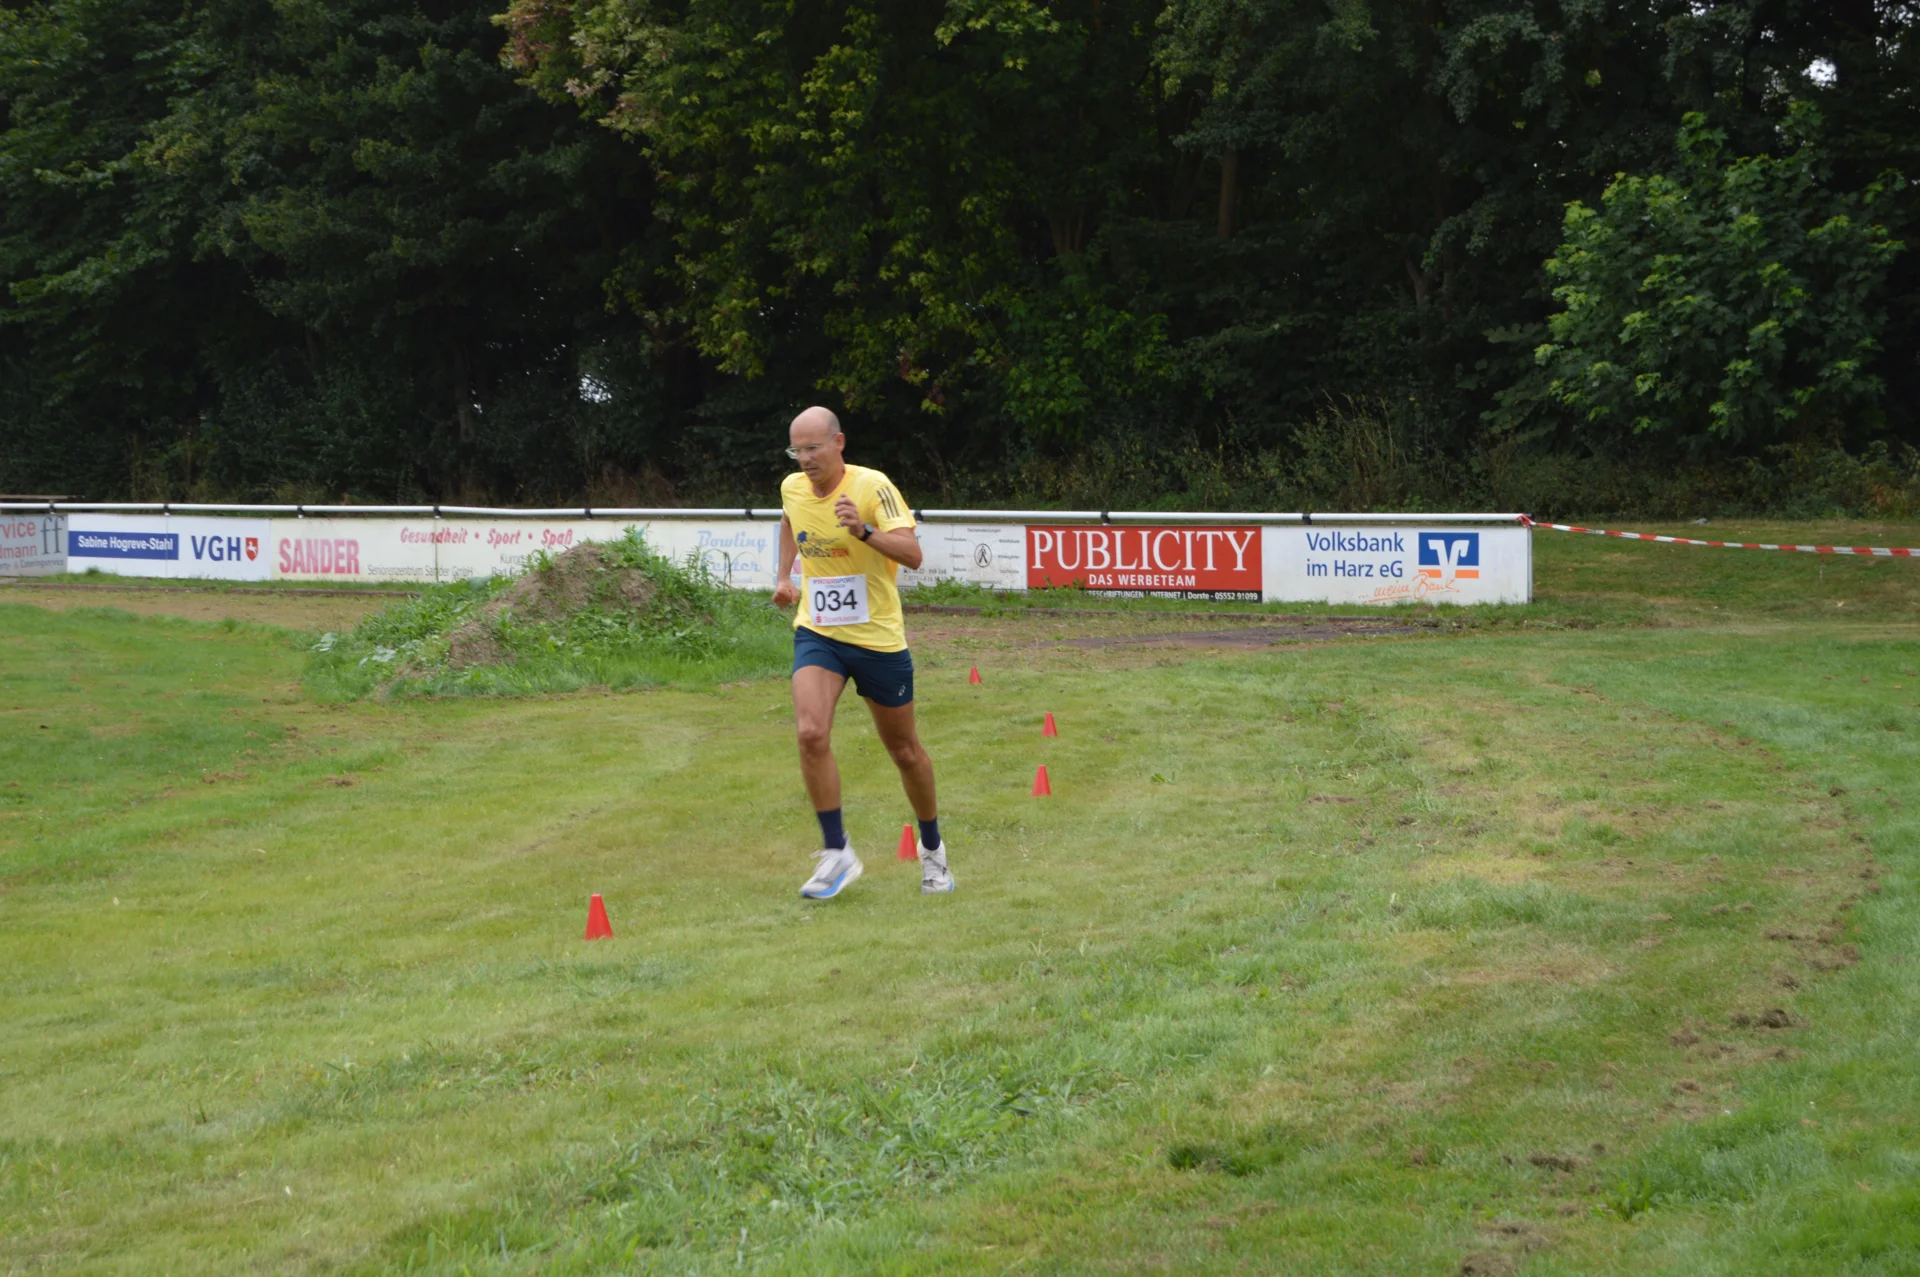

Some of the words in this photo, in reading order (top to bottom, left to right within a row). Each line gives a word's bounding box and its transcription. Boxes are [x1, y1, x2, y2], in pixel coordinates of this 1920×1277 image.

[78, 535, 108, 548] Sabine
[109, 536, 174, 552] Hogreve-Stahl
[191, 535, 242, 562] VGH
[400, 526, 468, 544] Gesundheit
[487, 528, 522, 549] Sport
[541, 528, 574, 549] Spaß
[697, 529, 768, 553] Bowling
[1306, 531, 1405, 553] Volksbank
[279, 537, 360, 575] SANDER
[1030, 530, 1256, 571] PUBLICITY
[1306, 559, 1328, 577] im
[1334, 560, 1374, 578] Harz
[1379, 560, 1404, 578] eG
[1088, 574, 1113, 586] DAS
[1118, 574, 1196, 587] WERBETEAM
[814, 589, 858, 612] 034
[1187, 591, 1210, 600] Dorste
[1215, 591, 1236, 601] 05552
[1237, 592, 1258, 602] 91099
